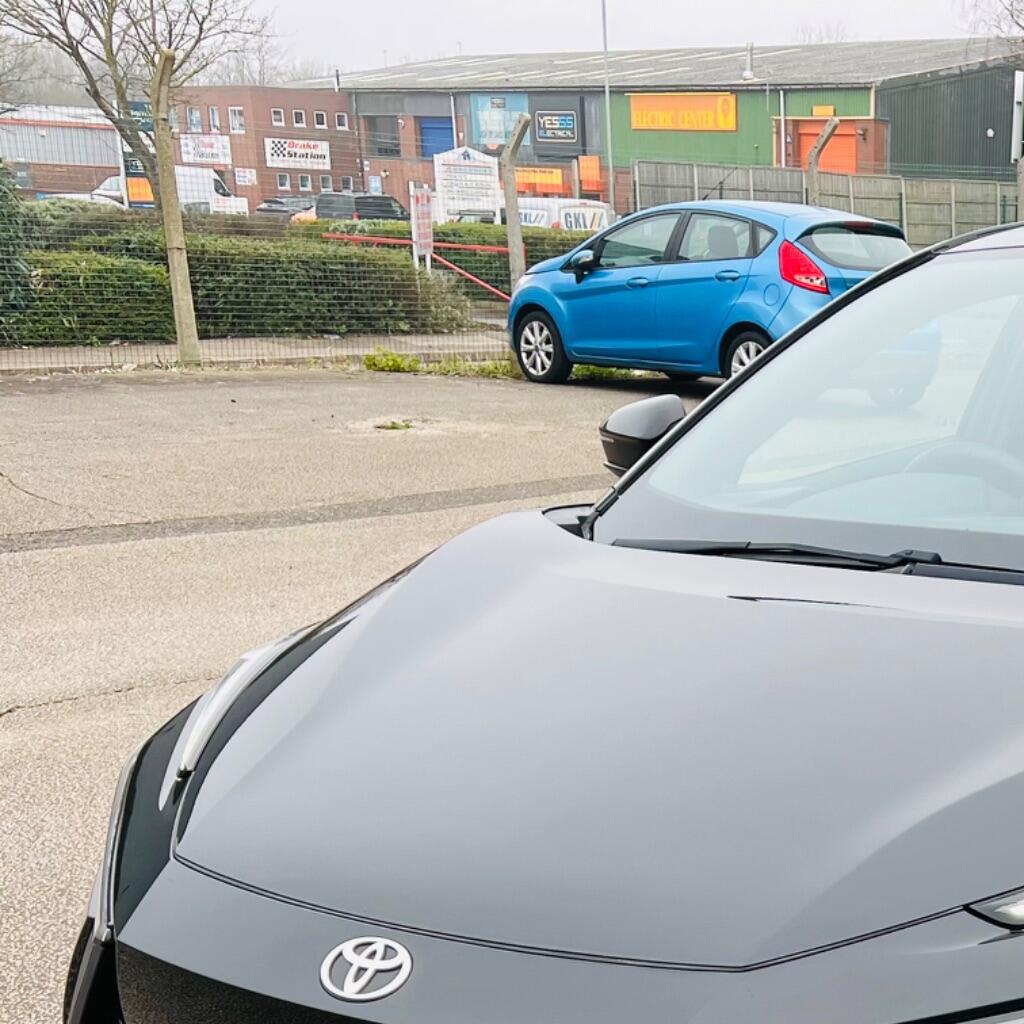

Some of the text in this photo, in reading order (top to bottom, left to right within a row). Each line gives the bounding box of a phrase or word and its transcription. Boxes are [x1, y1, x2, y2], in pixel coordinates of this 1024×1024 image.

[634, 111, 714, 128] ELECTRIC CENTER
[287, 140, 319, 149] Brake
[287, 150, 326, 160] Station
